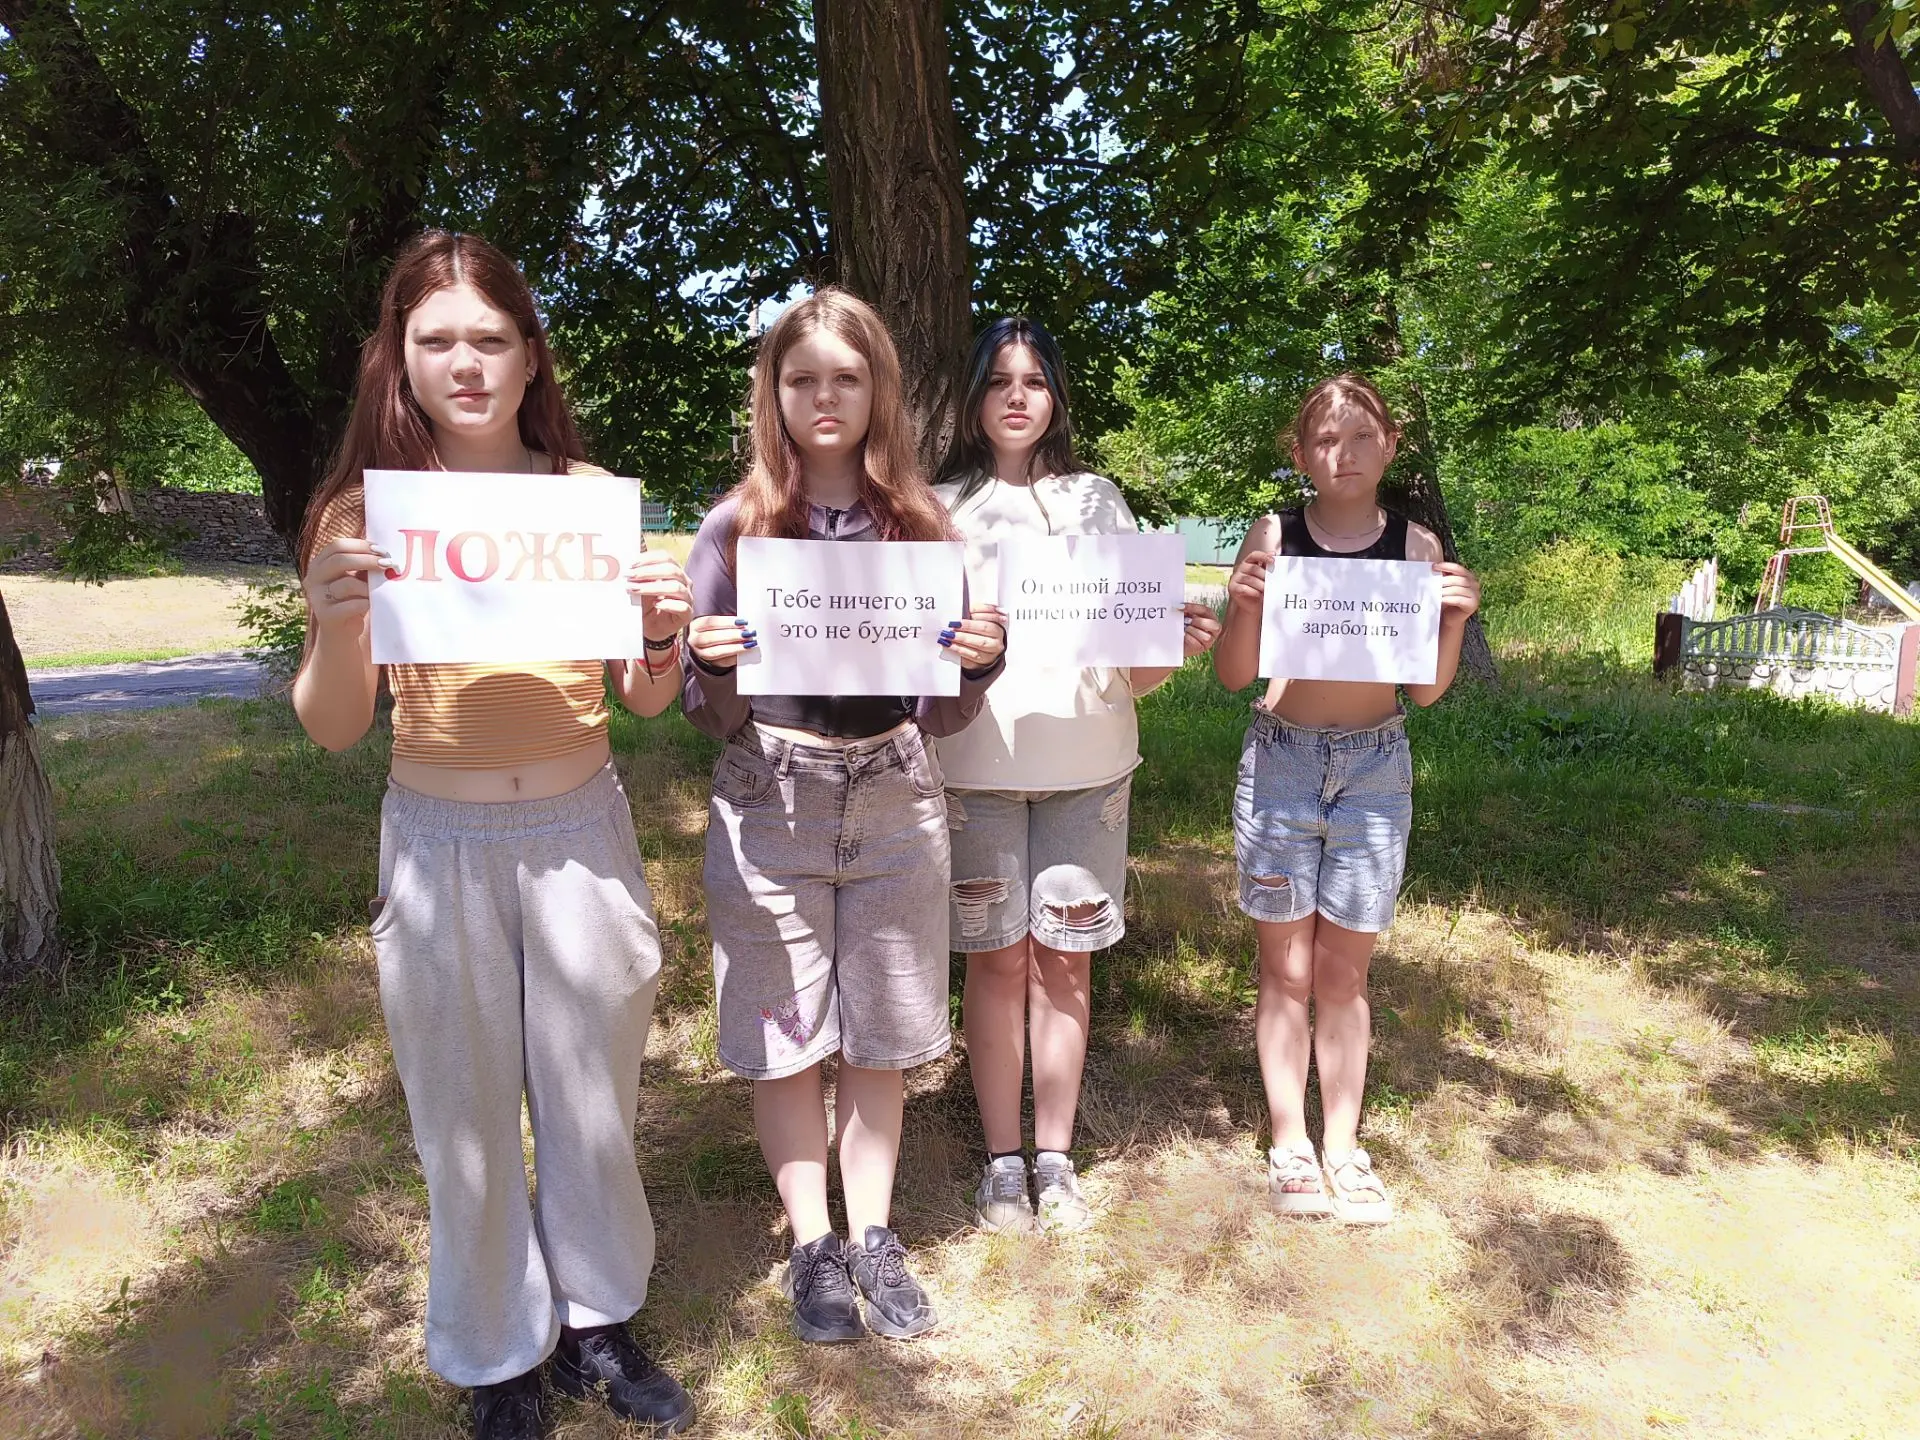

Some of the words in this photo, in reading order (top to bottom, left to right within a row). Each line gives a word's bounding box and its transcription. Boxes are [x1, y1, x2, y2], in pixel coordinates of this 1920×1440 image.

[384, 529, 621, 583] ЛОЖЬ
[1114, 580, 1162, 596] дозы
[766, 588, 822, 609] Тебе
[829, 595, 907, 610] ничего
[914, 595, 937, 610] за
[1283, 593, 1307, 610] На
[1313, 598, 1355, 612] этом
[1361, 600, 1421, 614] можно
[1086, 607, 1108, 620] не
[1113, 603, 1167, 624] будет
[780, 623, 818, 639] это
[825, 624, 851, 639] не
[858, 620, 922, 644] будет
[1302, 619, 1399, 638] заработать
